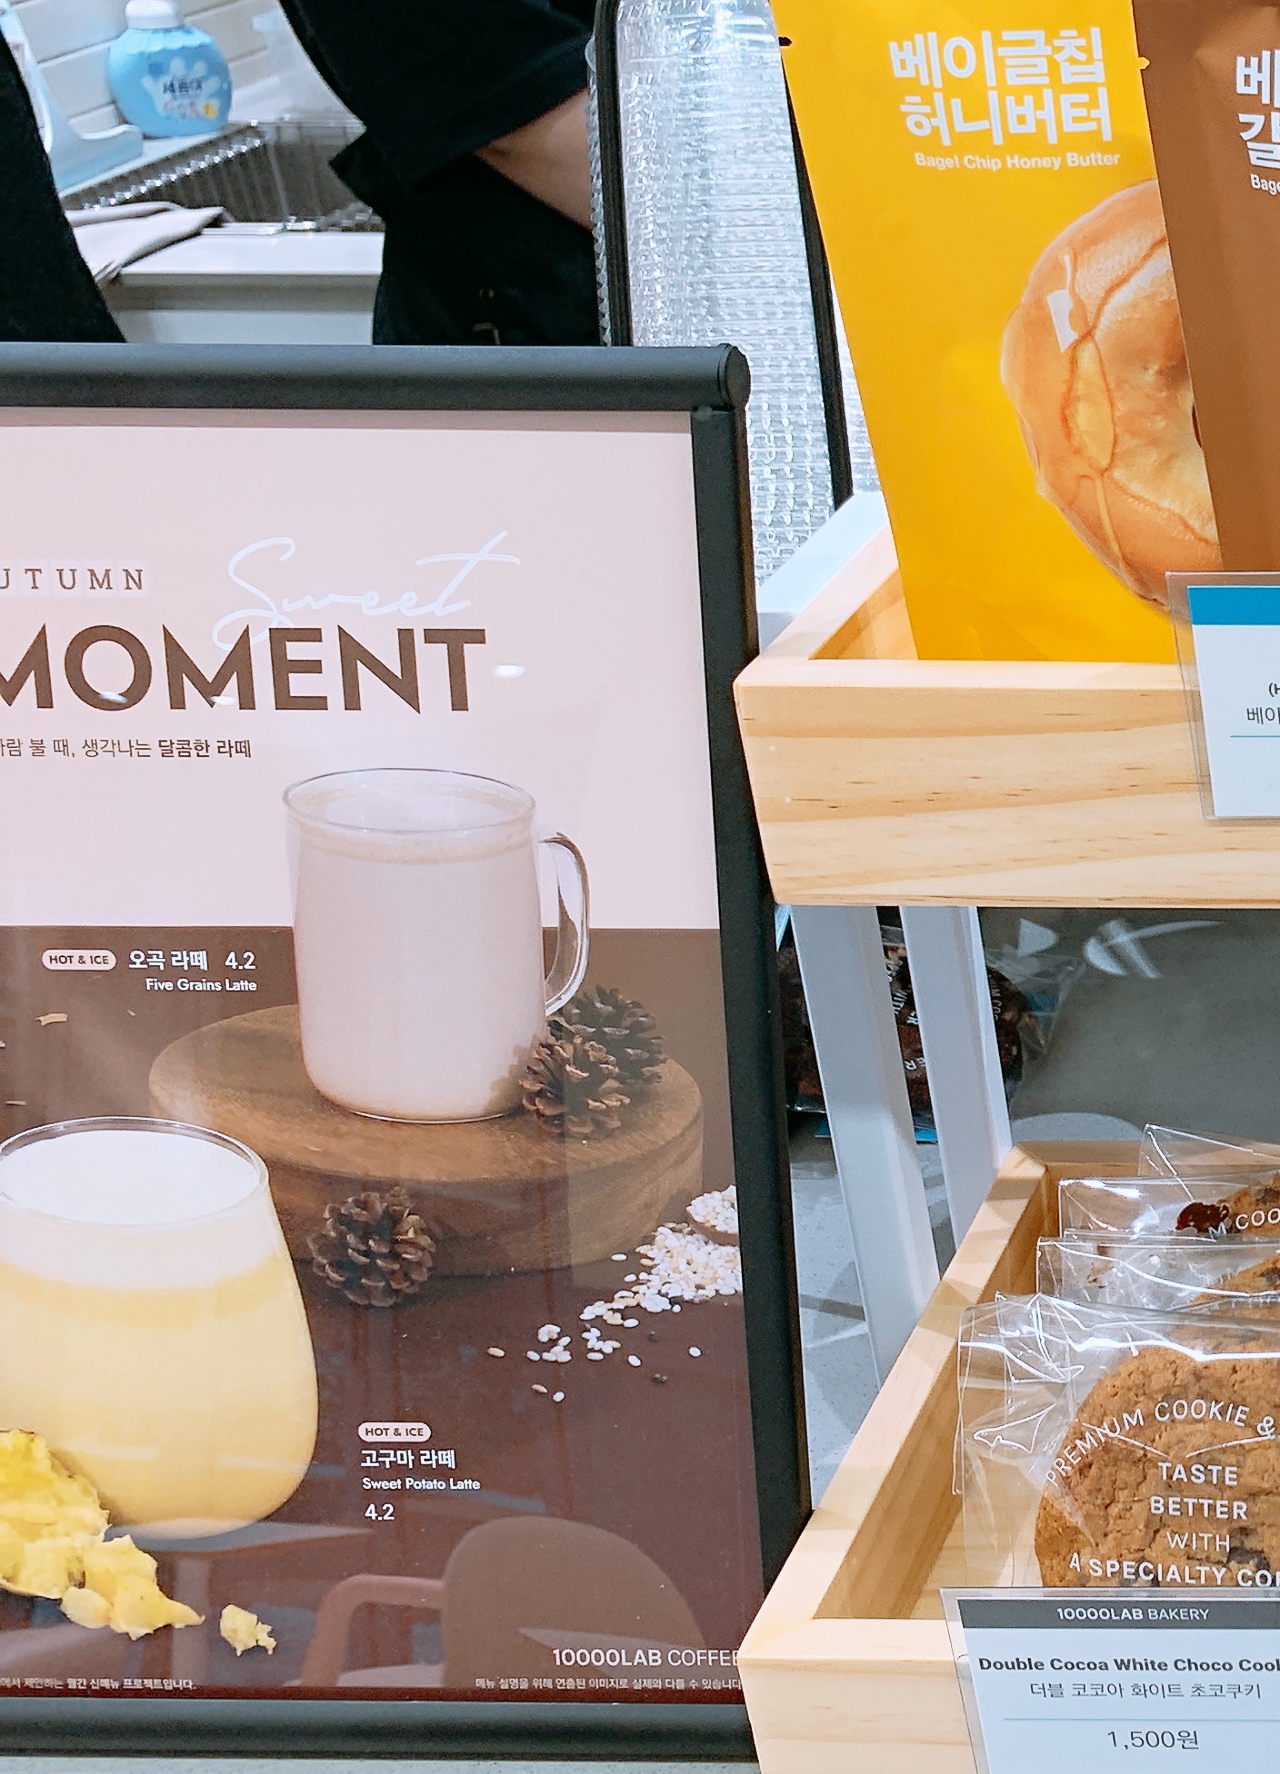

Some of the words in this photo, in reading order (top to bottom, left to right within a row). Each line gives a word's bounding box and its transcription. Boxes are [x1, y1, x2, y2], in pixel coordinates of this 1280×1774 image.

[889, 27, 1105, 88] 베이글칩
[900, 87, 1112, 146] 허니버터
[914, 152, 960, 169] Bagel
[963, 154, 1001, 171] Chip
[1007, 154, 1061, 170] Honey
[1066, 151, 1120, 167] Butter
[212, 531, 522, 650] Sweet
[0, 623, 487, 714] MOMENT
[29, 738, 46, 758] 불
[53, 738, 75, 758] 때,
[82, 738, 152, 758] 생각나는
[158, 738, 210, 758] 달콤한
[216, 738, 251, 758] 라떼
[49, 955, 73, 965] HOT
[90, 955, 109, 965] ICE
[129, 950, 165, 970] 오곡
[171, 950, 208, 971] 라떼
[225, 951, 256, 970] 4.2
[146, 978, 173, 991] Five
[177, 978, 222, 991] Grains
[225, 978, 257, 991] Latte
[365, 1427, 390, 1437] HOT
[405, 1427, 424, 1437] ICE
[1045, 1407, 1144, 1486] PREMIUM
[1154, 1398, 1250, 1428] COOKIE
[361, 1449, 415, 1468] 고구마
[420, 1449, 456, 1469] 라떼
[362, 1477, 402, 1490] Sweet
[405, 1477, 446, 1490] Potato
[449, 1477, 481, 1490] Latte
[1158, 1461, 1239, 1486] TASTE
[365, 1503, 395, 1520] 4.2
[1150, 1496, 1248, 1520] BETTER
[1166, 1532, 1231, 1552] WITH
[1088, 1558, 1227, 1586] SPECIALTY
[1057, 1607, 1144, 1621] 10000LAB
[1148, 1608, 1210, 1621] BAKERY
[553, 1649, 662, 1666] 10000LAB
[667, 1650, 739, 1666] COFFEE
[979, 1657, 1045, 1672] Double
[1050, 1658, 1109, 1672] Cocoa
[1113, 1658, 1168, 1672] White
[1173, 1658, 1234, 1672] Choco
[589, 1678, 629, 1690] 이미지로
[1030, 1683, 1065, 1699] 더블
[1071, 1683, 1124, 1699] 코코아
[1130, 1683, 1185, 1699] 화이트
[1190, 1683, 1262, 1699] 초코쿠키
[1107, 1729, 1200, 1750] 1,500원
